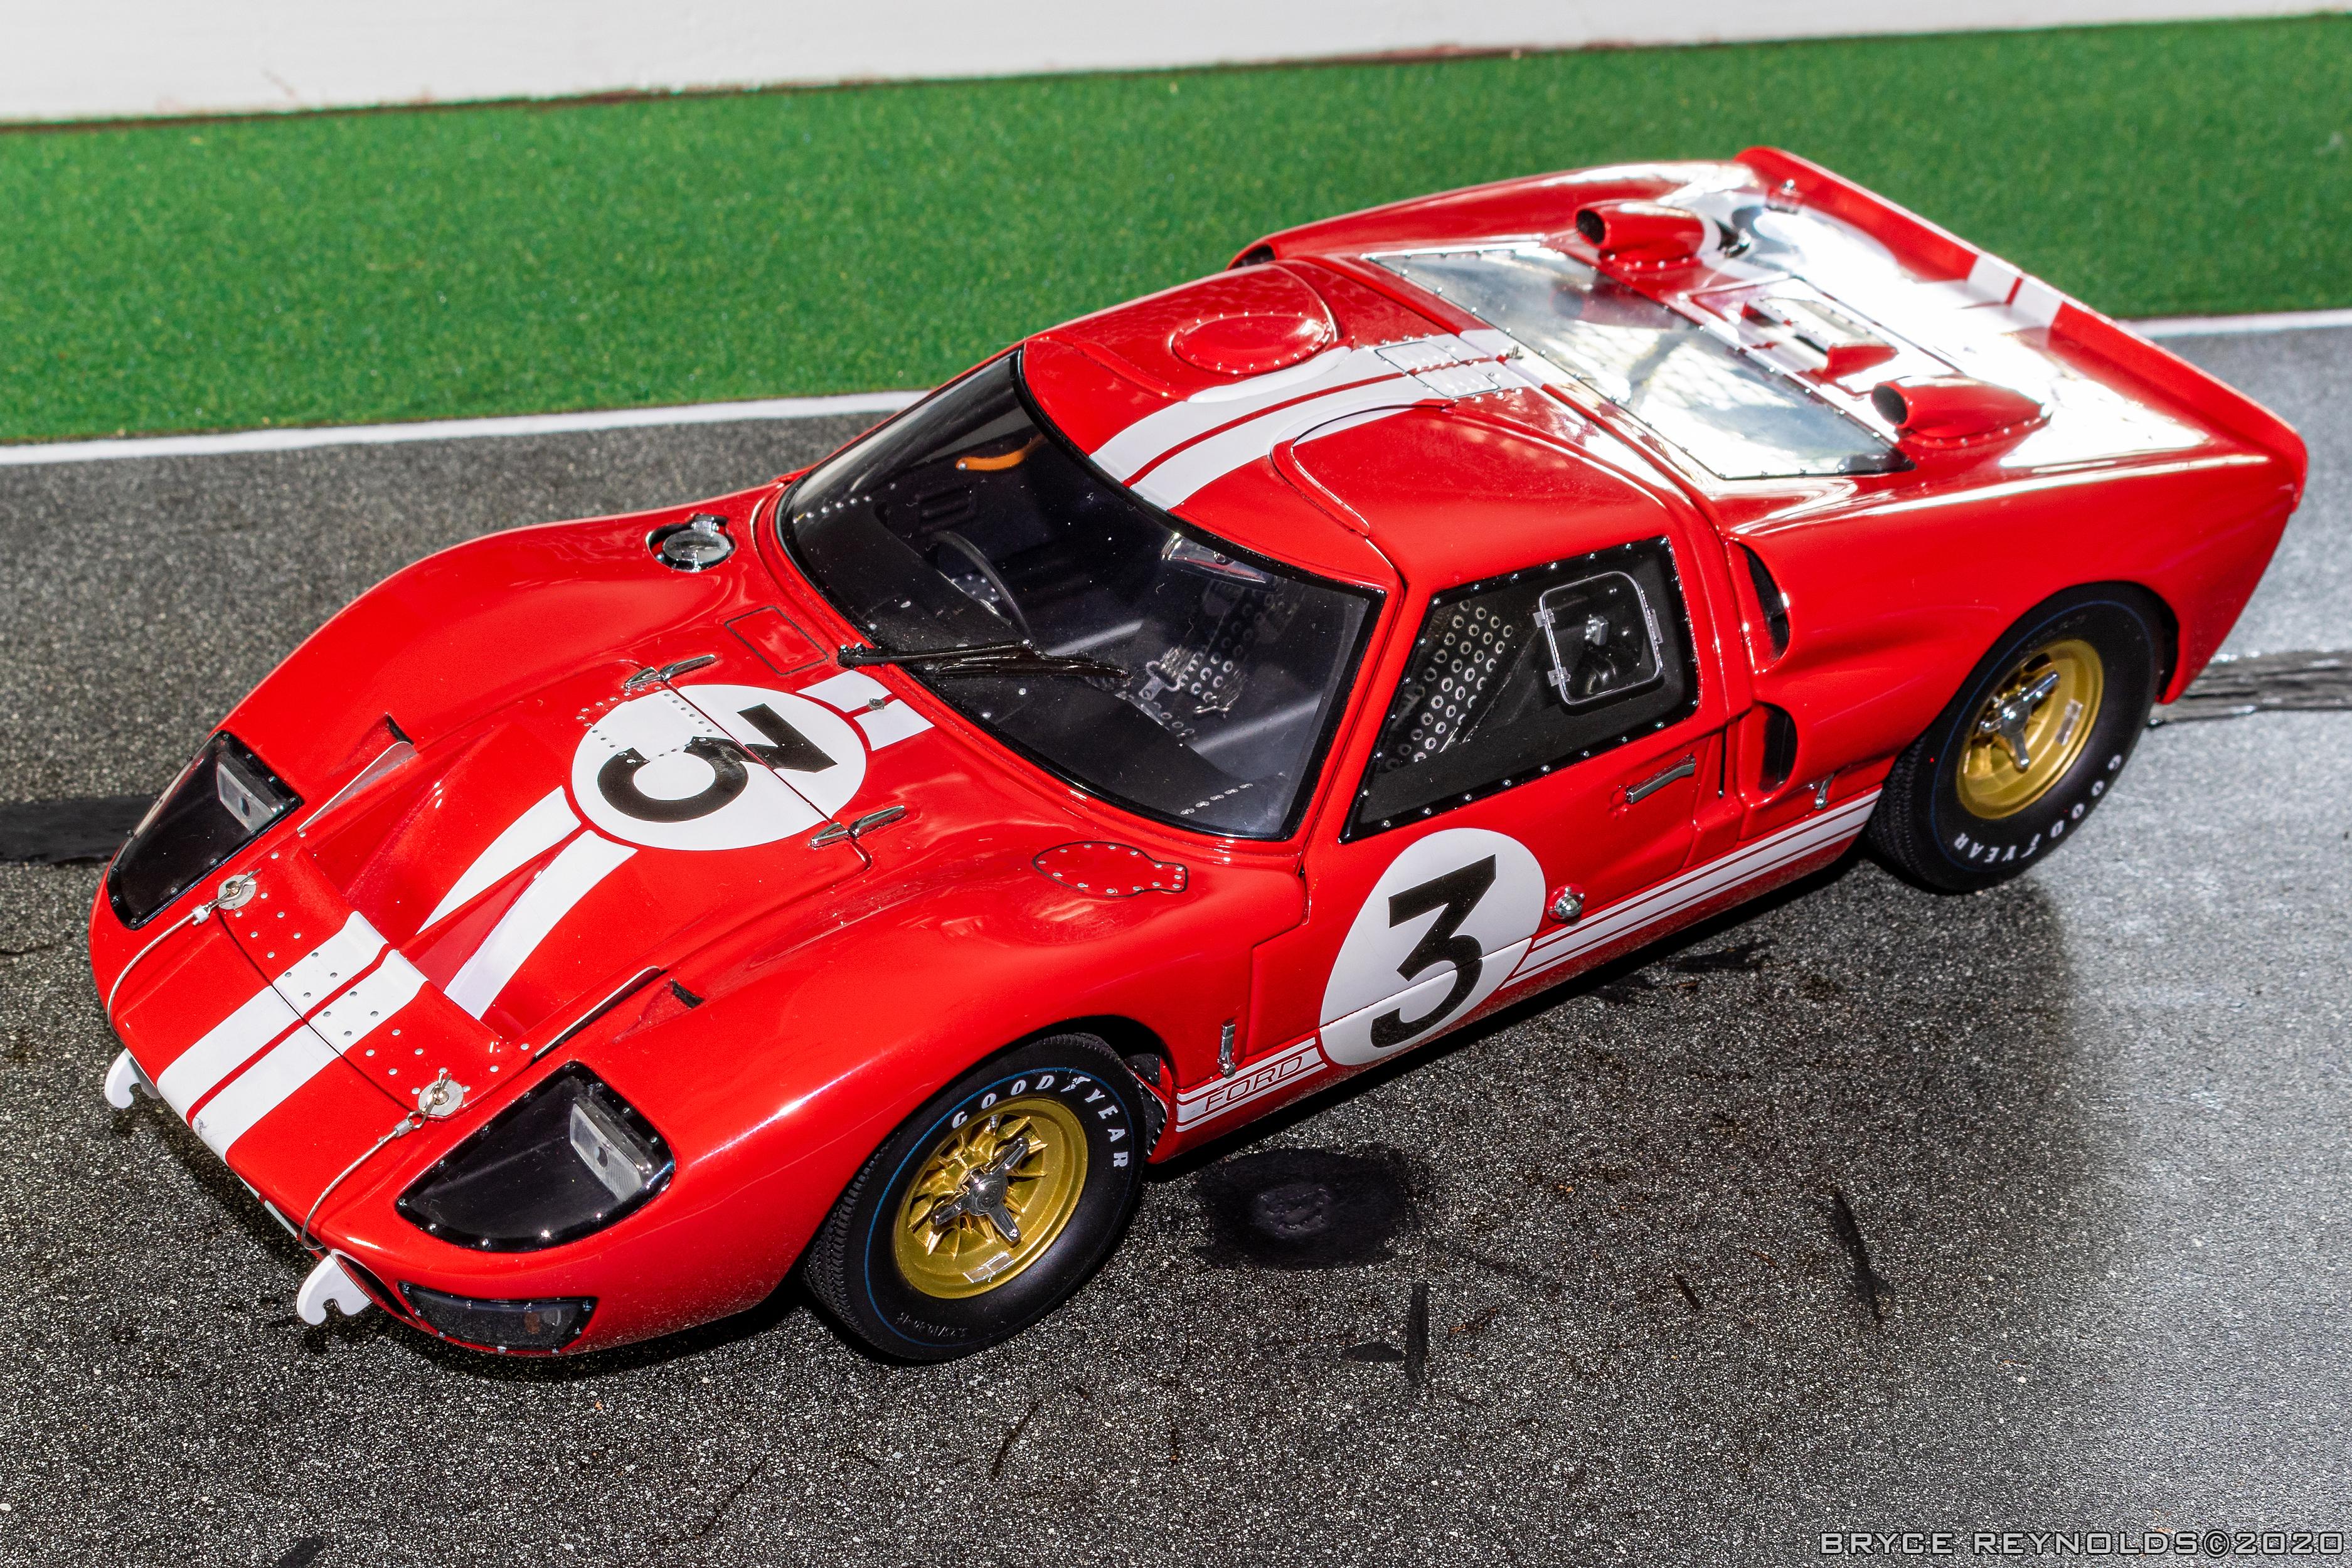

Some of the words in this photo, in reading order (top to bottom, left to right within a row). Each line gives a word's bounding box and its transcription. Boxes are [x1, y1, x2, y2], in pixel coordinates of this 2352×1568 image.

[597, 702, 839, 822] 3
[1954, 754, 2122, 863] GOODYEAR
[1370, 854, 1497, 1049] 3
[952, 1074, 1129, 1168] GOODYEAR
[1205, 1056, 1303, 1113] FORD
